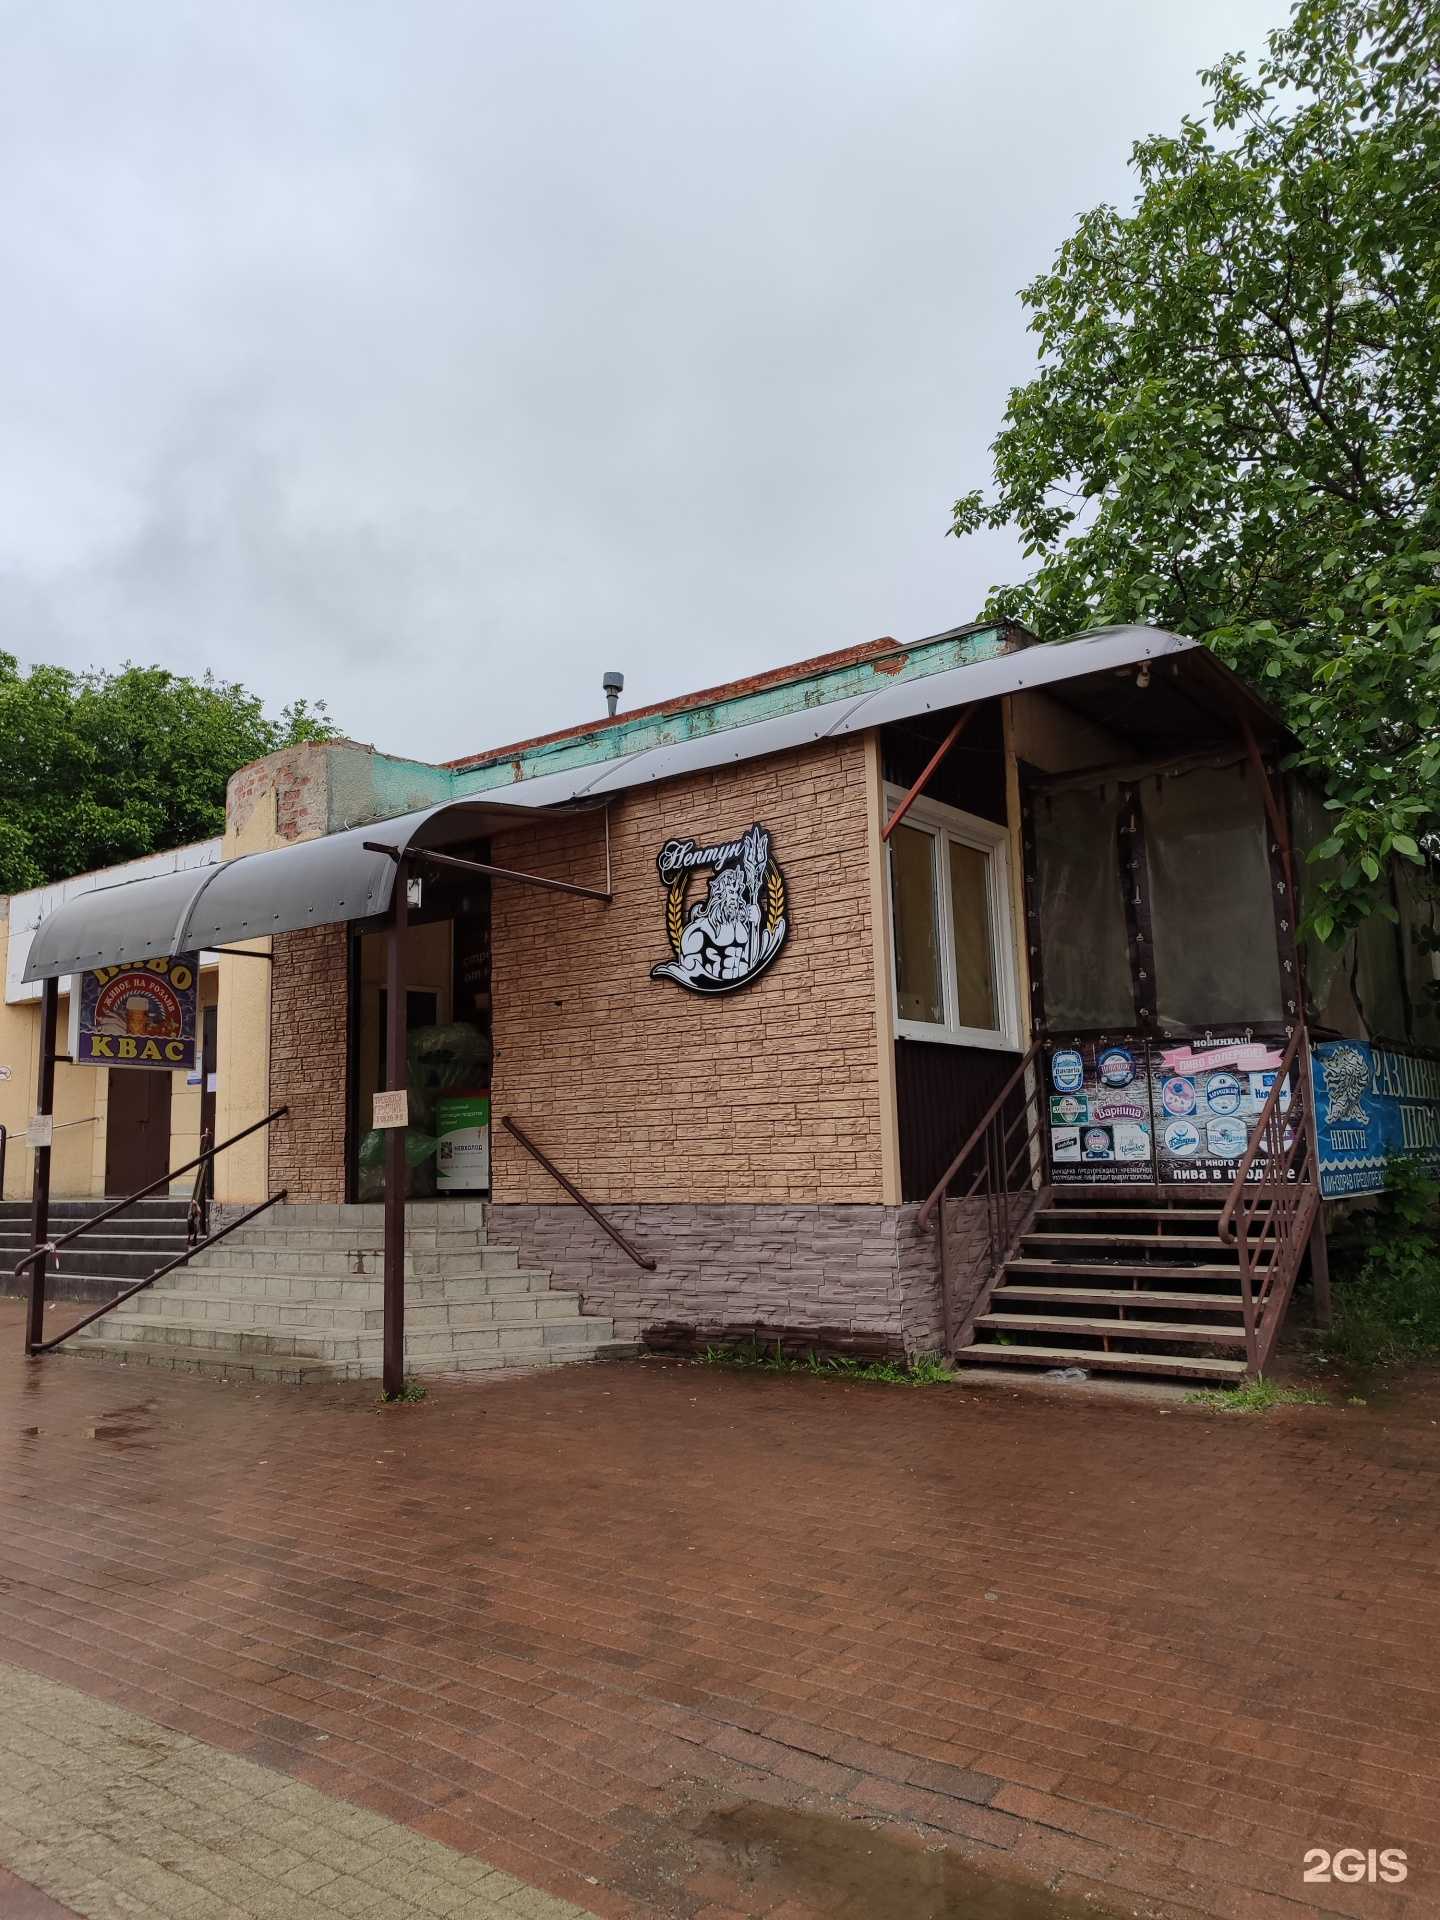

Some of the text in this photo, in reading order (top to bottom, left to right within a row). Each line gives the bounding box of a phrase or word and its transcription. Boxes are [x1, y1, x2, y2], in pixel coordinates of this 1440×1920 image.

[659, 841, 745, 885] Нептун
[91, 1035, 186, 1062] КВАС
[1099, 1105, 1142, 1119] Варница
[1330, 1129, 1368, 1151] НЕПТУН
[1205, 1160, 1234, 1168] много
[1173, 1169, 1207, 1180] пива
[1213, 1169, 1222, 1179] в
